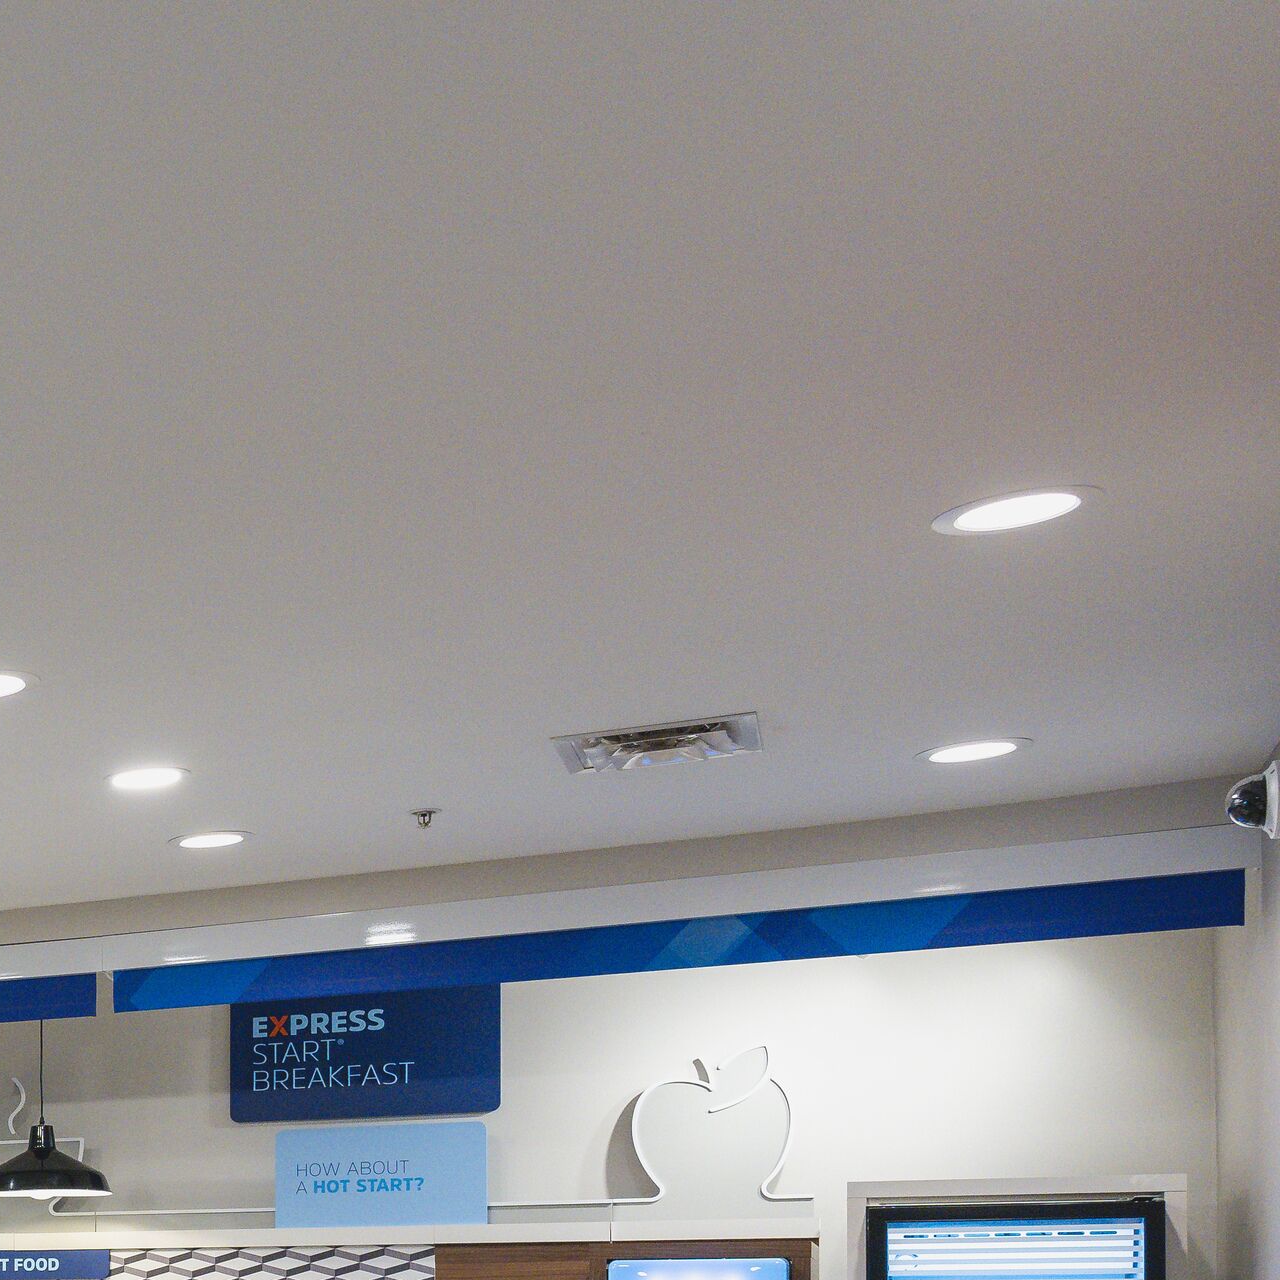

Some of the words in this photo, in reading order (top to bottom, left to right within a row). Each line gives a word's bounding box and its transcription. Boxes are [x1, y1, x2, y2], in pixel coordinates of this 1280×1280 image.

[252, 1008, 385, 1038] EXPRESS
[252, 1061, 415, 1092] BREAKFAST
[296, 1162, 340, 1177] HOW
[347, 1159, 409, 1176] ABOUT
[296, 1180, 308, 1195] A
[313, 1179, 350, 1194] HOT
[356, 1177, 425, 1193] START?
[14, 1257, 60, 1271] FOOD
